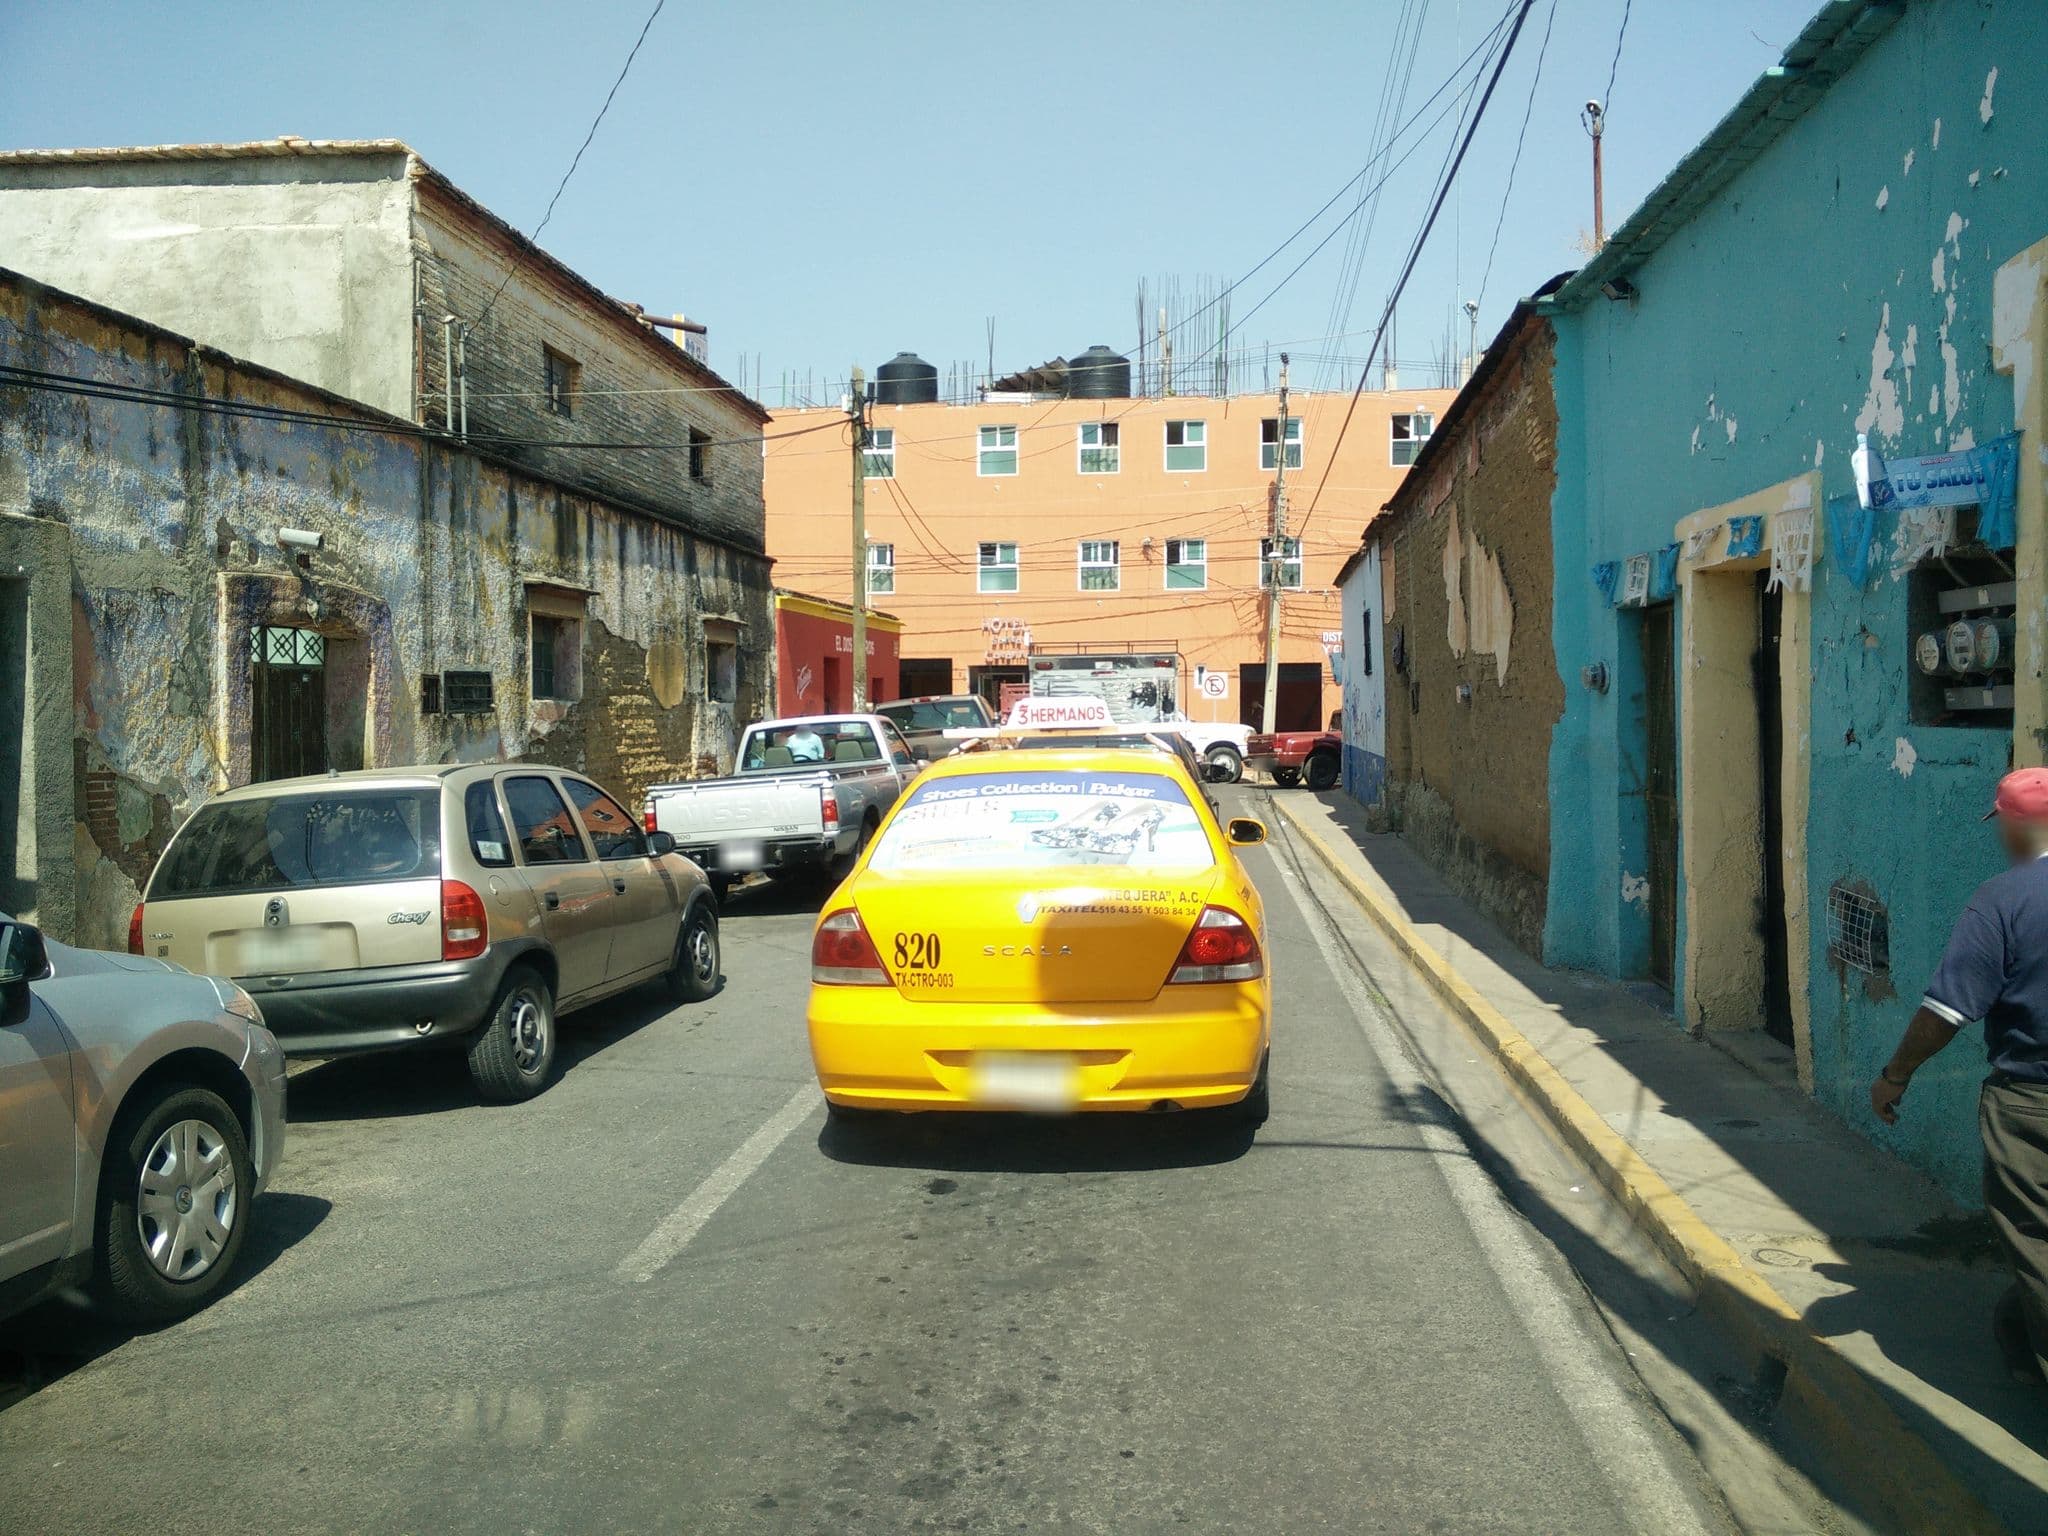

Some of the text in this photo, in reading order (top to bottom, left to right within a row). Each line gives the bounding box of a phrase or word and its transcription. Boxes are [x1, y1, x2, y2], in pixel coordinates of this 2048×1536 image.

[1896, 471, 1921, 491] TU
[1031, 706, 1104, 723] HERMANOS
[922, 782, 1078, 802] Shoes Collection
[678, 799, 793, 827] NISSAN
[773, 824, 799, 833] NISSAN
[386, 910, 432, 925] Chevy
[1118, 905, 1130, 914] 43
[1132, 905, 1143, 914] 55
[1145, 905, 1151, 914] Y
[1153, 906, 1170, 915] 503
[894, 931, 941, 969] 820
[983, 945, 1073, 957] SCALA
[896, 972, 954, 988] TX-CTRO-003
